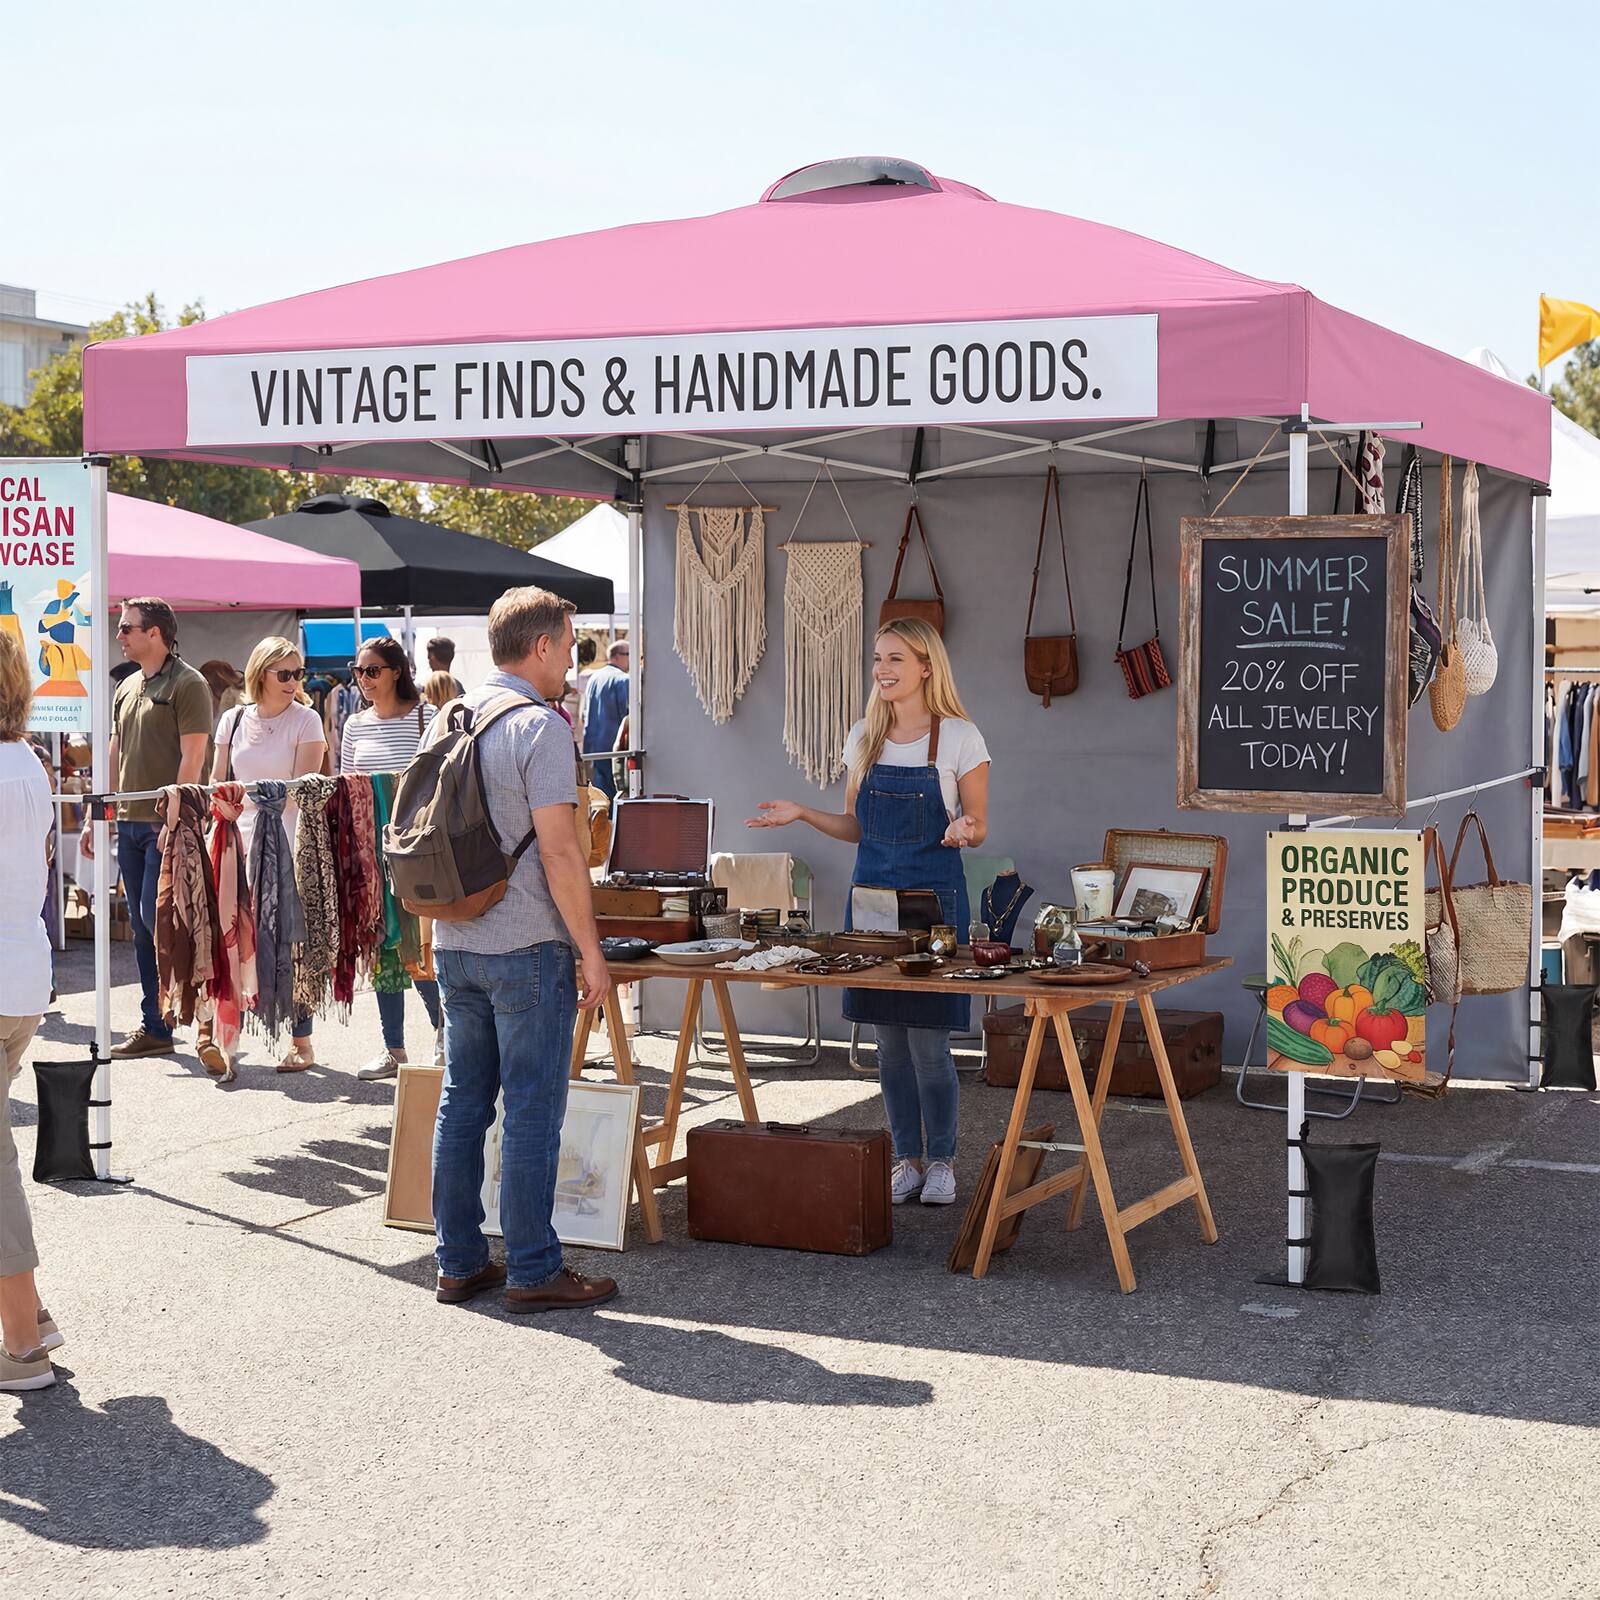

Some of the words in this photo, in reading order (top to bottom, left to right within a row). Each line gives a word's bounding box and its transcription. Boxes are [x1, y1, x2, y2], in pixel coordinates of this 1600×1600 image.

[251, 363, 437, 427] VINTAGE
[455, 358, 585, 420] FINDS
[602, 356, 636, 416] &
[655, 346, 912, 414] HANDMADE
[929, 338, 1102, 405] GOODS.
[0, 477, 47, 502] CAL
[3, 506, 75, 537] ISAN
[1216, 555, 1371, 593] SUMMER
[1240, 597, 1350, 637] SALE!
[1221, 660, 1286, 693] 20%
[1300, 663, 1359, 693] OFF
[1208, 703, 1253, 729] ALL
[1261, 705, 1379, 736] JEWELRY
[1240, 738, 1348, 775] TODAY!
[1281, 845, 1409, 876] ORGANIC
[1282, 877, 1409, 907] PRODUCE
[1282, 908, 1295, 927] &
[1301, 909, 1409, 931] PRESERVES
